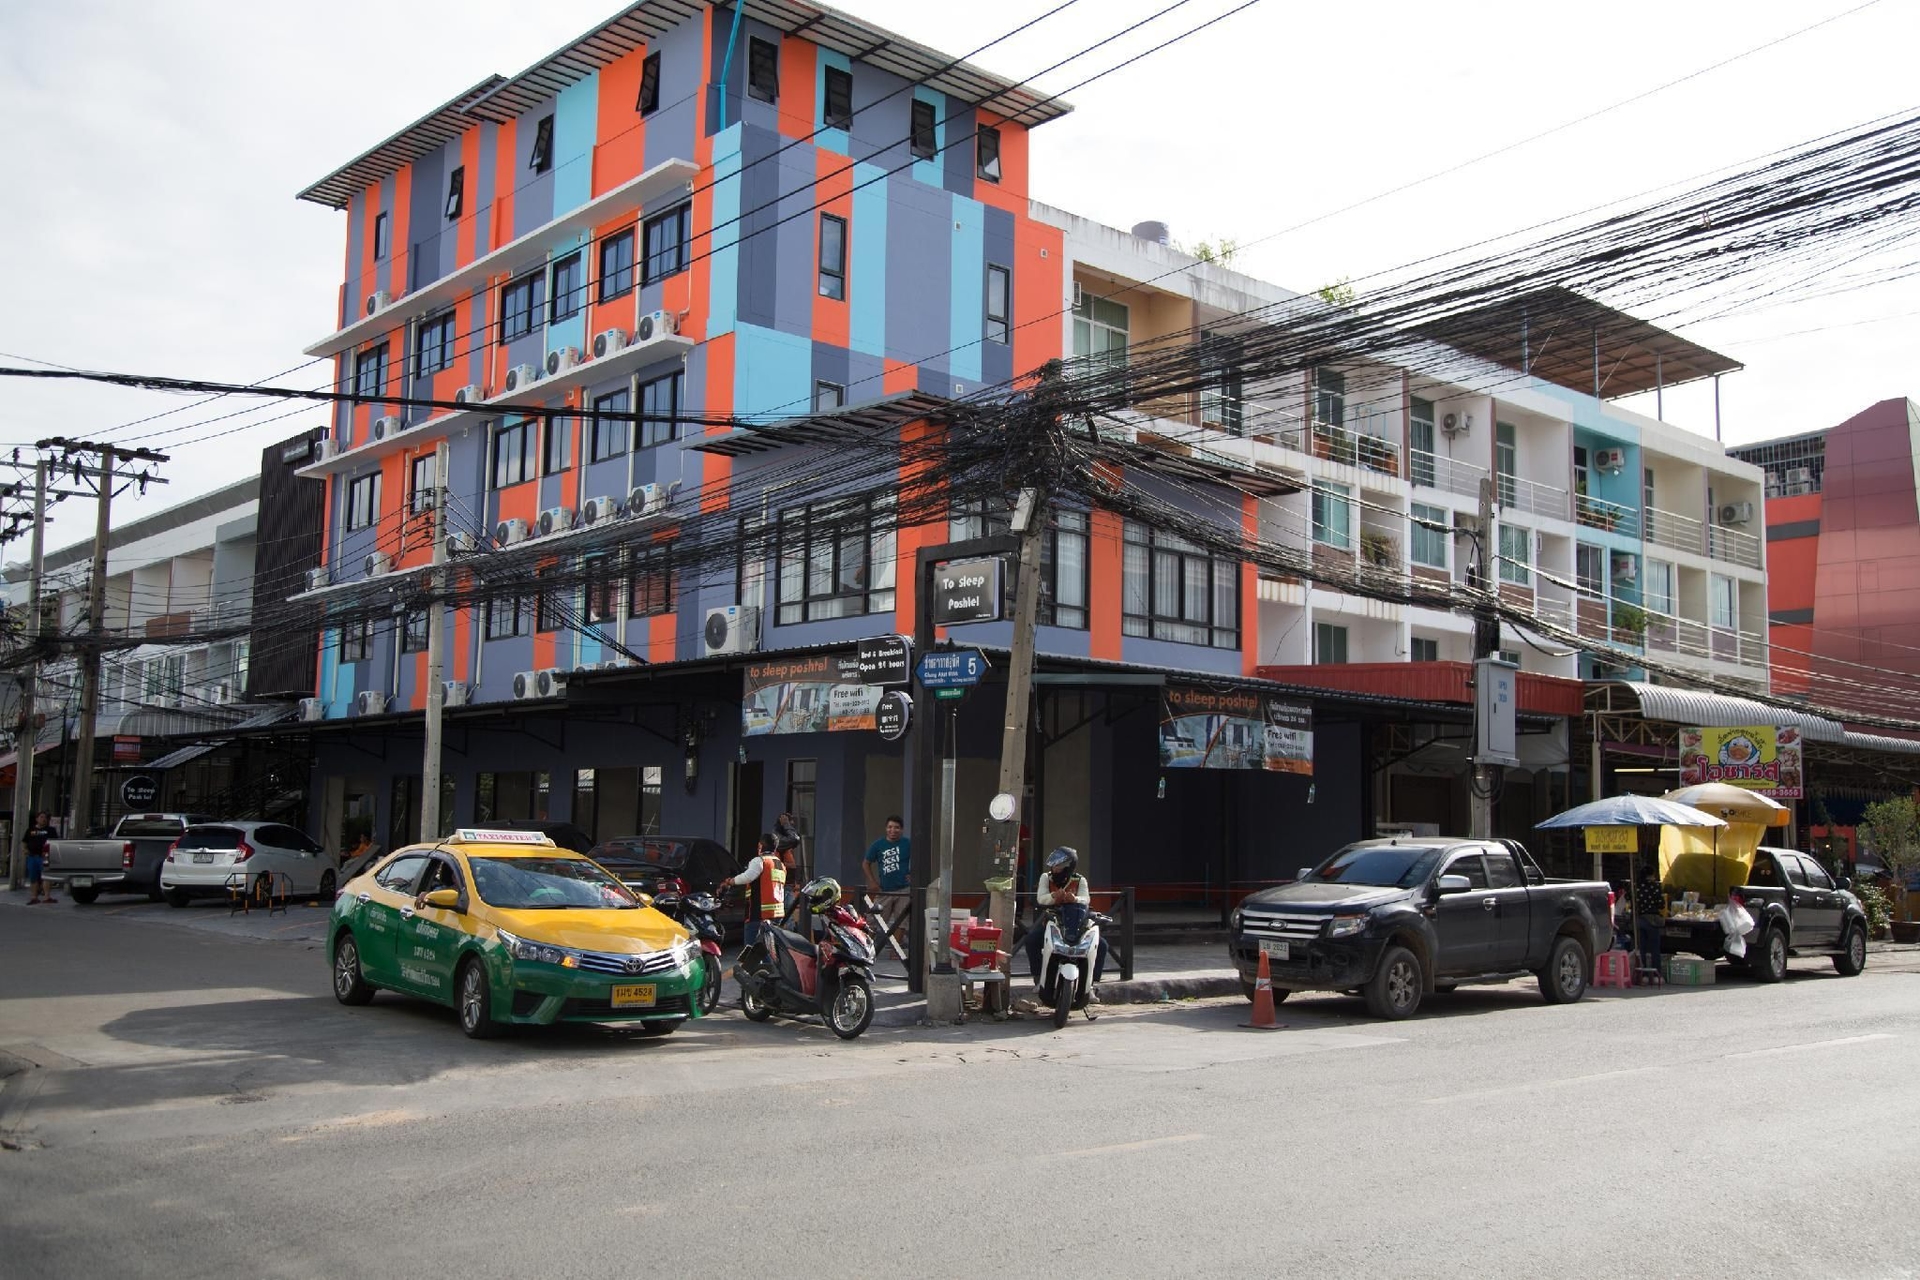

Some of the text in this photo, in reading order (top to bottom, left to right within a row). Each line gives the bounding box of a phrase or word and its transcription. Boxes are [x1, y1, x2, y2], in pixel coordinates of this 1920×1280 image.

[943, 575, 985, 590] To sleep
[948, 596, 980, 611] Poshtel
[861, 651, 871, 659] Bed
[879, 648, 903, 657] Breakfast
[750, 666, 760, 677] to
[762, 663, 787, 678] sleep
[790, 656, 829, 678] poshtel
[860, 663, 875, 672] Open
[968, 657, 977, 675] 5
[834, 687, 863, 698] Free wifi
[1169, 690, 1180, 703] to
[1184, 690, 1215, 708] sleep
[1218, 694, 1258, 709] poshtel
[1283, 731, 1297, 741] wifi
[1697, 755, 1781, 781] โอชารส
[882, 846, 900, 859] YES!
[882, 855, 900, 867] YES!
[883, 863, 900, 875] YES!
[633, 987, 653, 997] 4528
